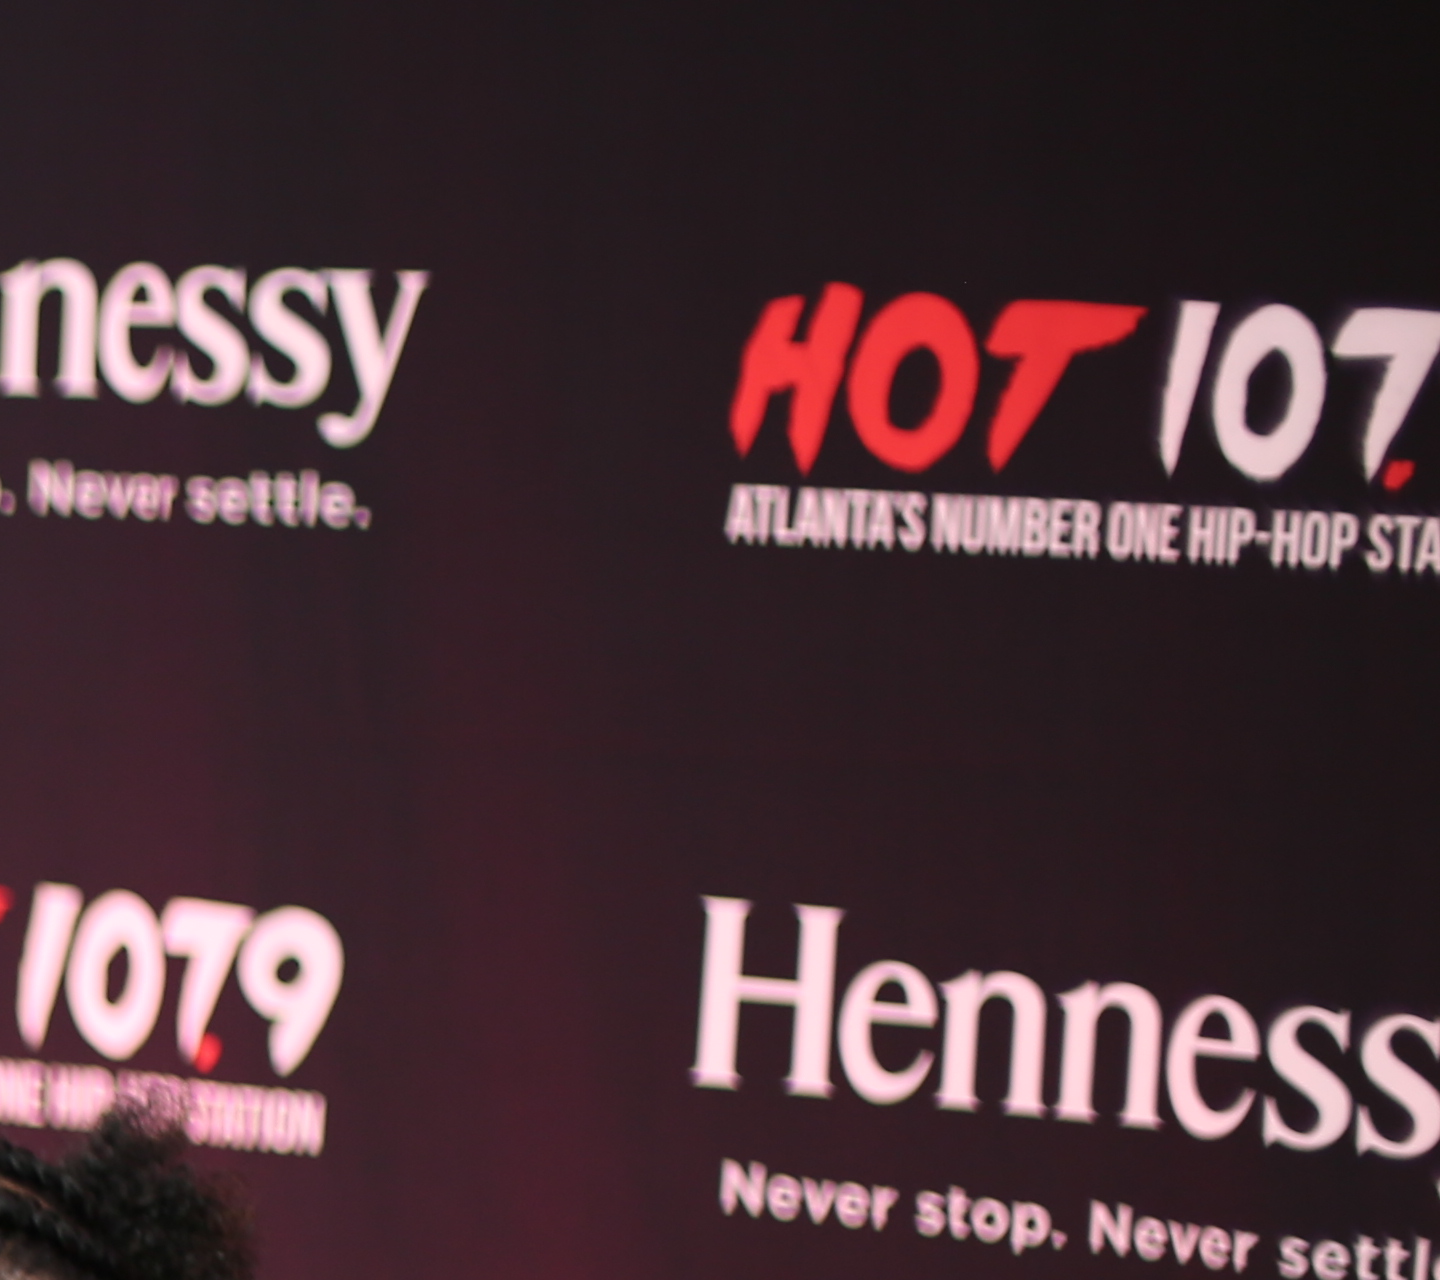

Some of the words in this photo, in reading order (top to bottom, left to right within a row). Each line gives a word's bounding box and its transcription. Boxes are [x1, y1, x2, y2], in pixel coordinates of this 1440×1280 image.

[729, 281, 1149, 477] HOT
[26, 458, 179, 521] Never
[726, 484, 927, 553] ATLANTA'S
[930, 494, 1104, 559] NUMBER
[1107, 503, 1183, 563] ONE
[1187, 507, 1360, 571] HIP-HOP
[690, 893, 1440, 1165] Henness
[717, 1158, 898, 1230] Never
[915, 1185, 1068, 1256] stop.
[1088, 1198, 1260, 1273] Never
